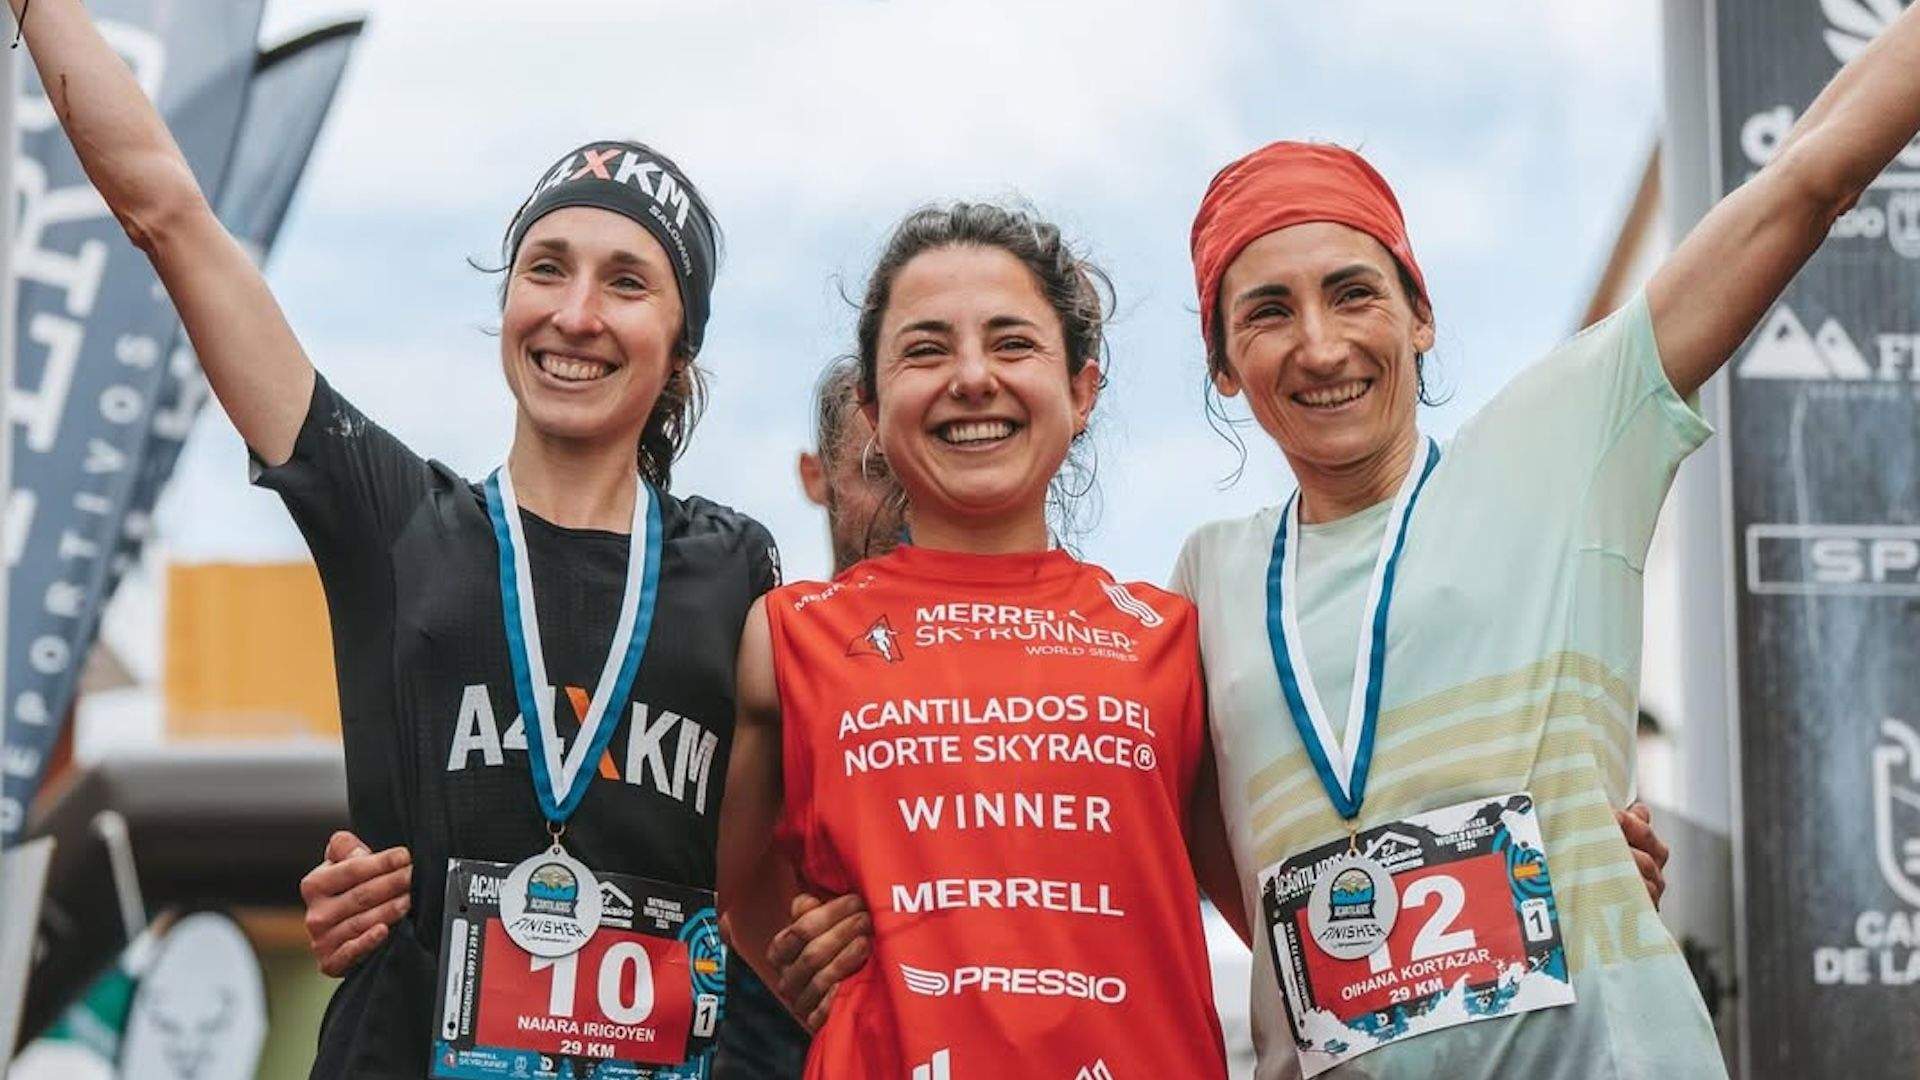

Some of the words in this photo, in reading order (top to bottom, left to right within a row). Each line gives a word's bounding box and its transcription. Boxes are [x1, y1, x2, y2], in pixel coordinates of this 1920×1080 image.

[1812, 540, 1920, 581] SP
[915, 603, 1086, 624] MERRE
[1025, 645, 1084, 657] WORLD
[1088, 649, 1139, 662] SERIES
[838, 695, 1088, 740] ACANTILADOS
[1097, 695, 1156, 738] DEL
[844, 735, 963, 777] NORTE
[898, 792, 1112, 833] WINNER
[891, 877, 1126, 917] MERRELL
[508, 917, 588, 937] FINISHER
[1317, 924, 1386, 941] FINISHER
[1530, 909, 1544, 933] 1
[1855, 911, 1920, 948] CA
[530, 941, 655, 1025] 10
[953, 966, 1127, 1005] PRESSIO
[1341, 973, 1400, 1001] OIHANA
[1400, 948, 1491, 981] KORTAZAR
[1389, 986, 1412, 1004] 29
[1415, 977, 1445, 997] KM
[517, 1015, 579, 1035] NAIARA
[583, 1022, 656, 1042] IRIGOYEN
[701, 1005, 711, 1031] 1
[560, 1039, 583, 1055] 29
[587, 1041, 615, 1059] KM
